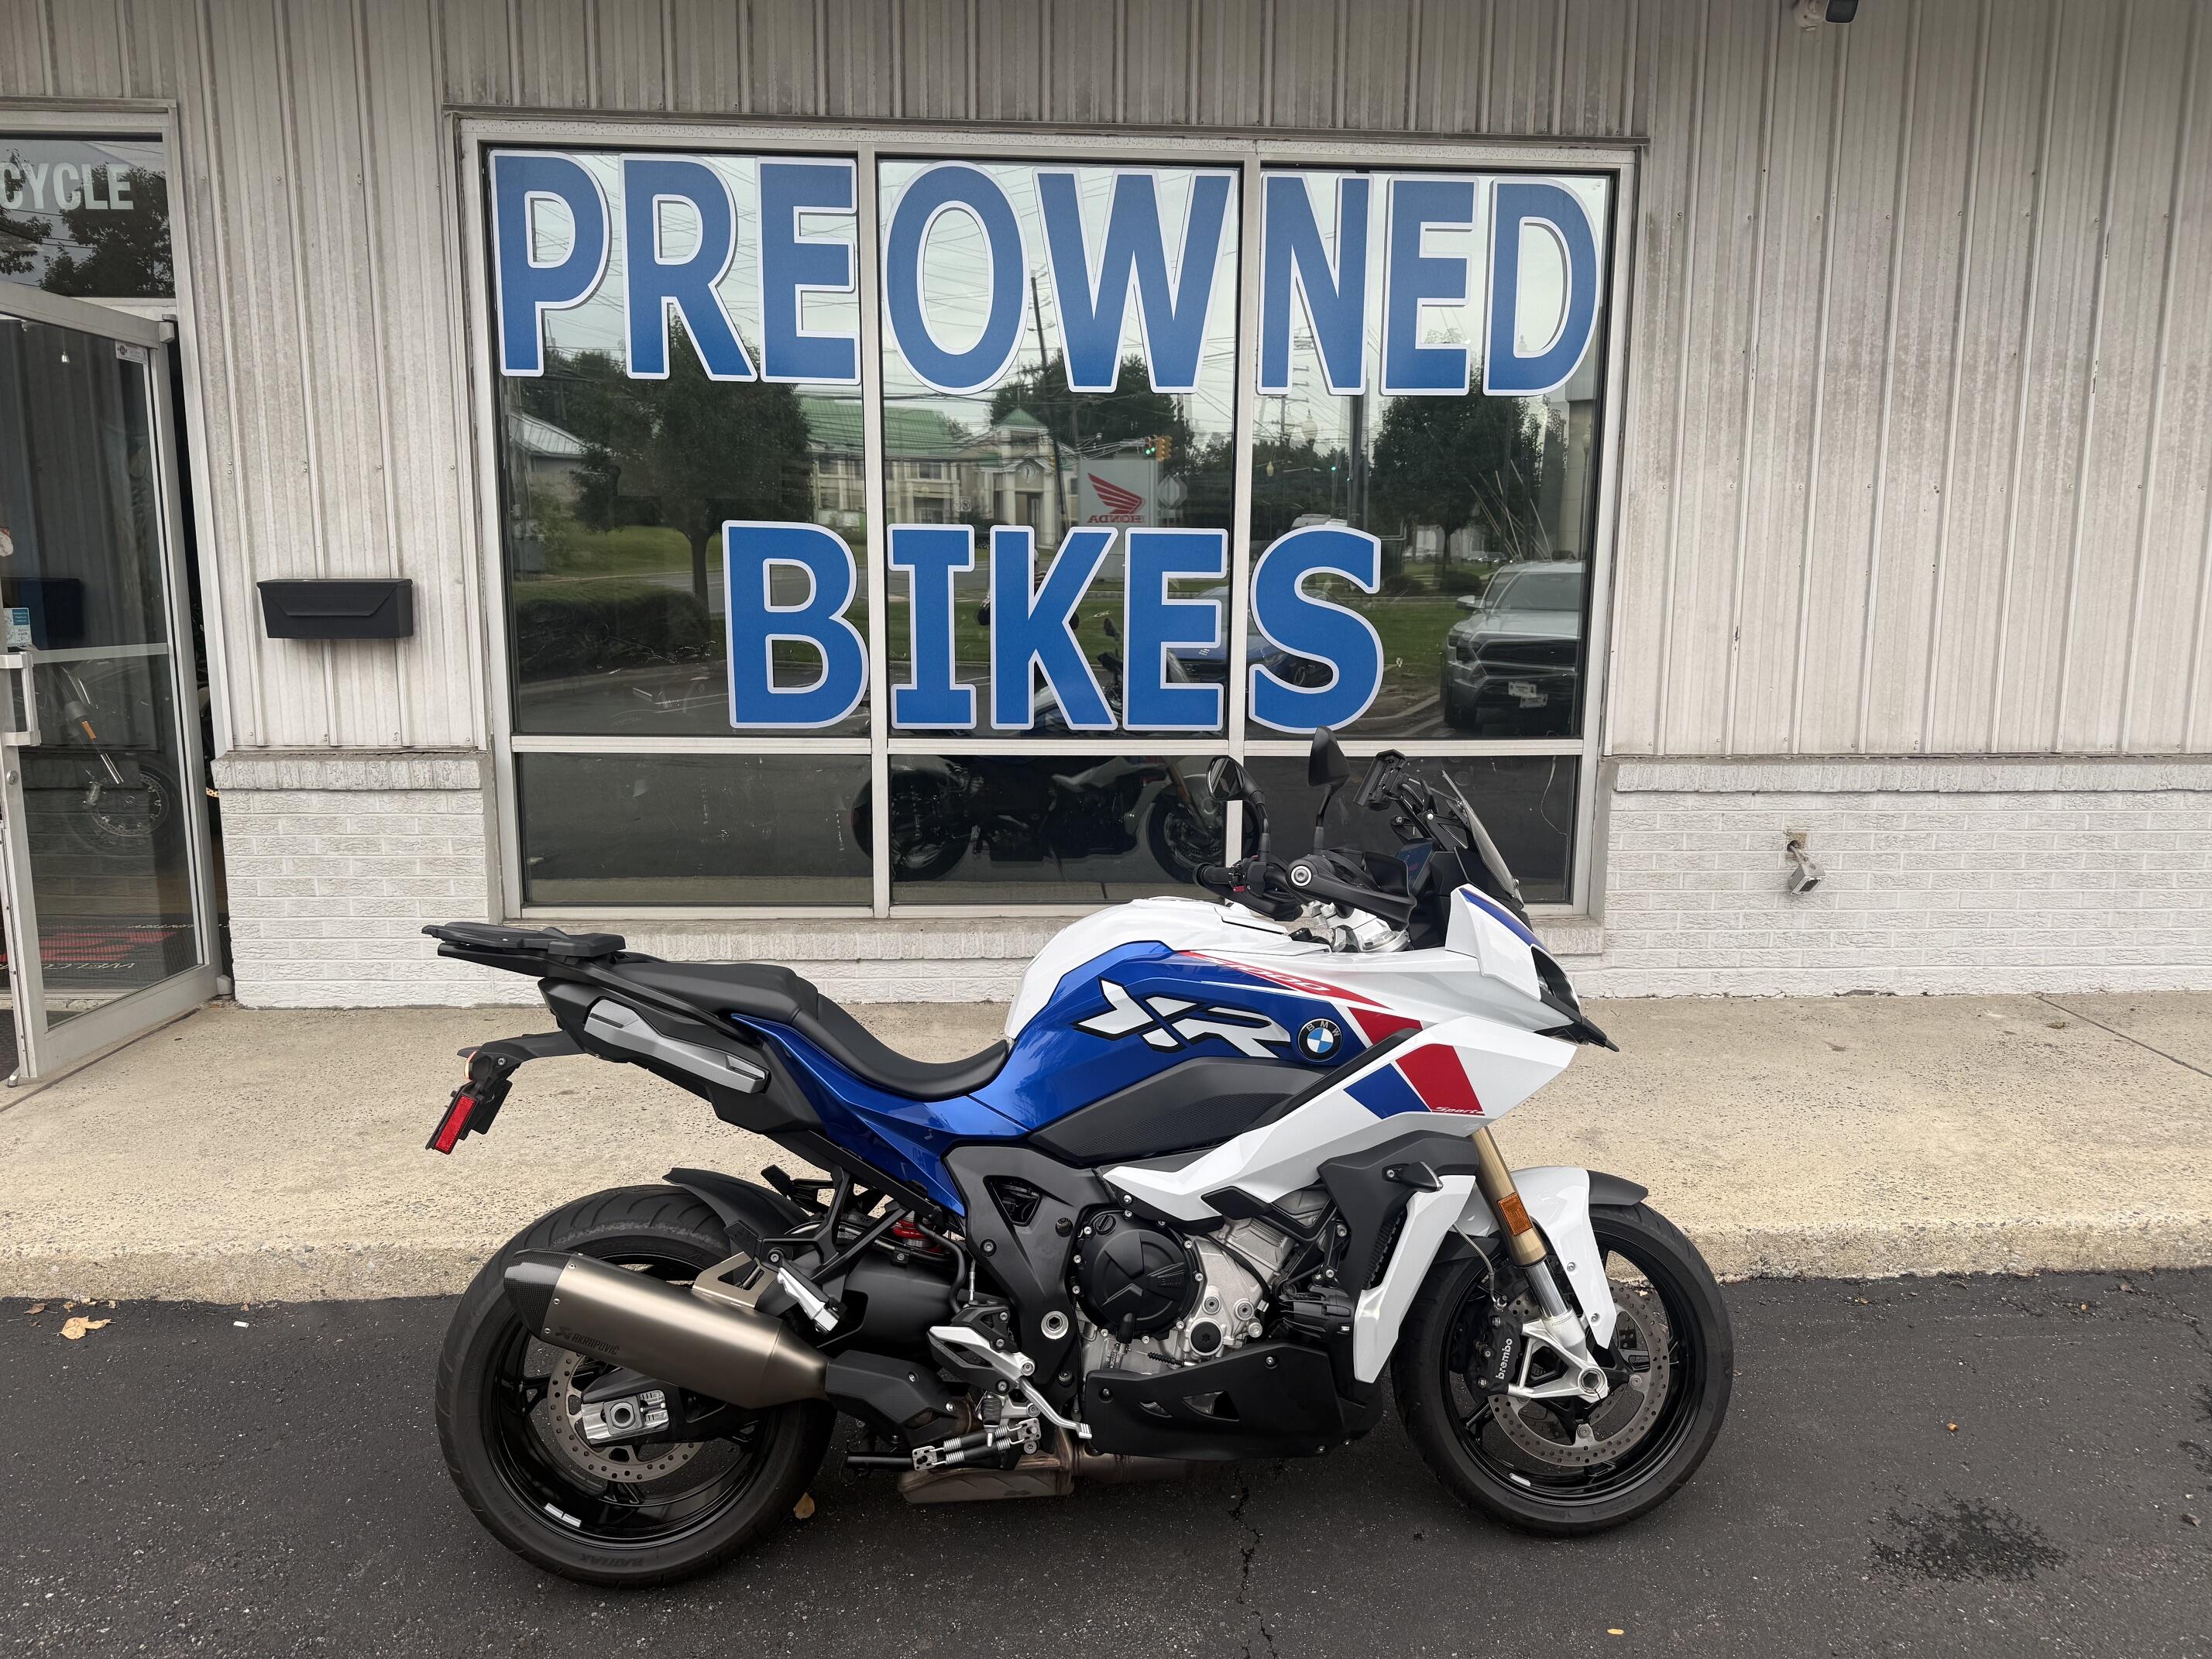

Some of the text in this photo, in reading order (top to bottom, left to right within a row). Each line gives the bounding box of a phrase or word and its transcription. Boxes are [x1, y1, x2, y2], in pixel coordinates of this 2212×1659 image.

[489, 149, 1601, 396] PREOWNED
[722, 520, 1383, 734] BIKES
[1306, 1020, 1341, 1037] BMW
[1495, 1338, 1513, 1380] brembo
